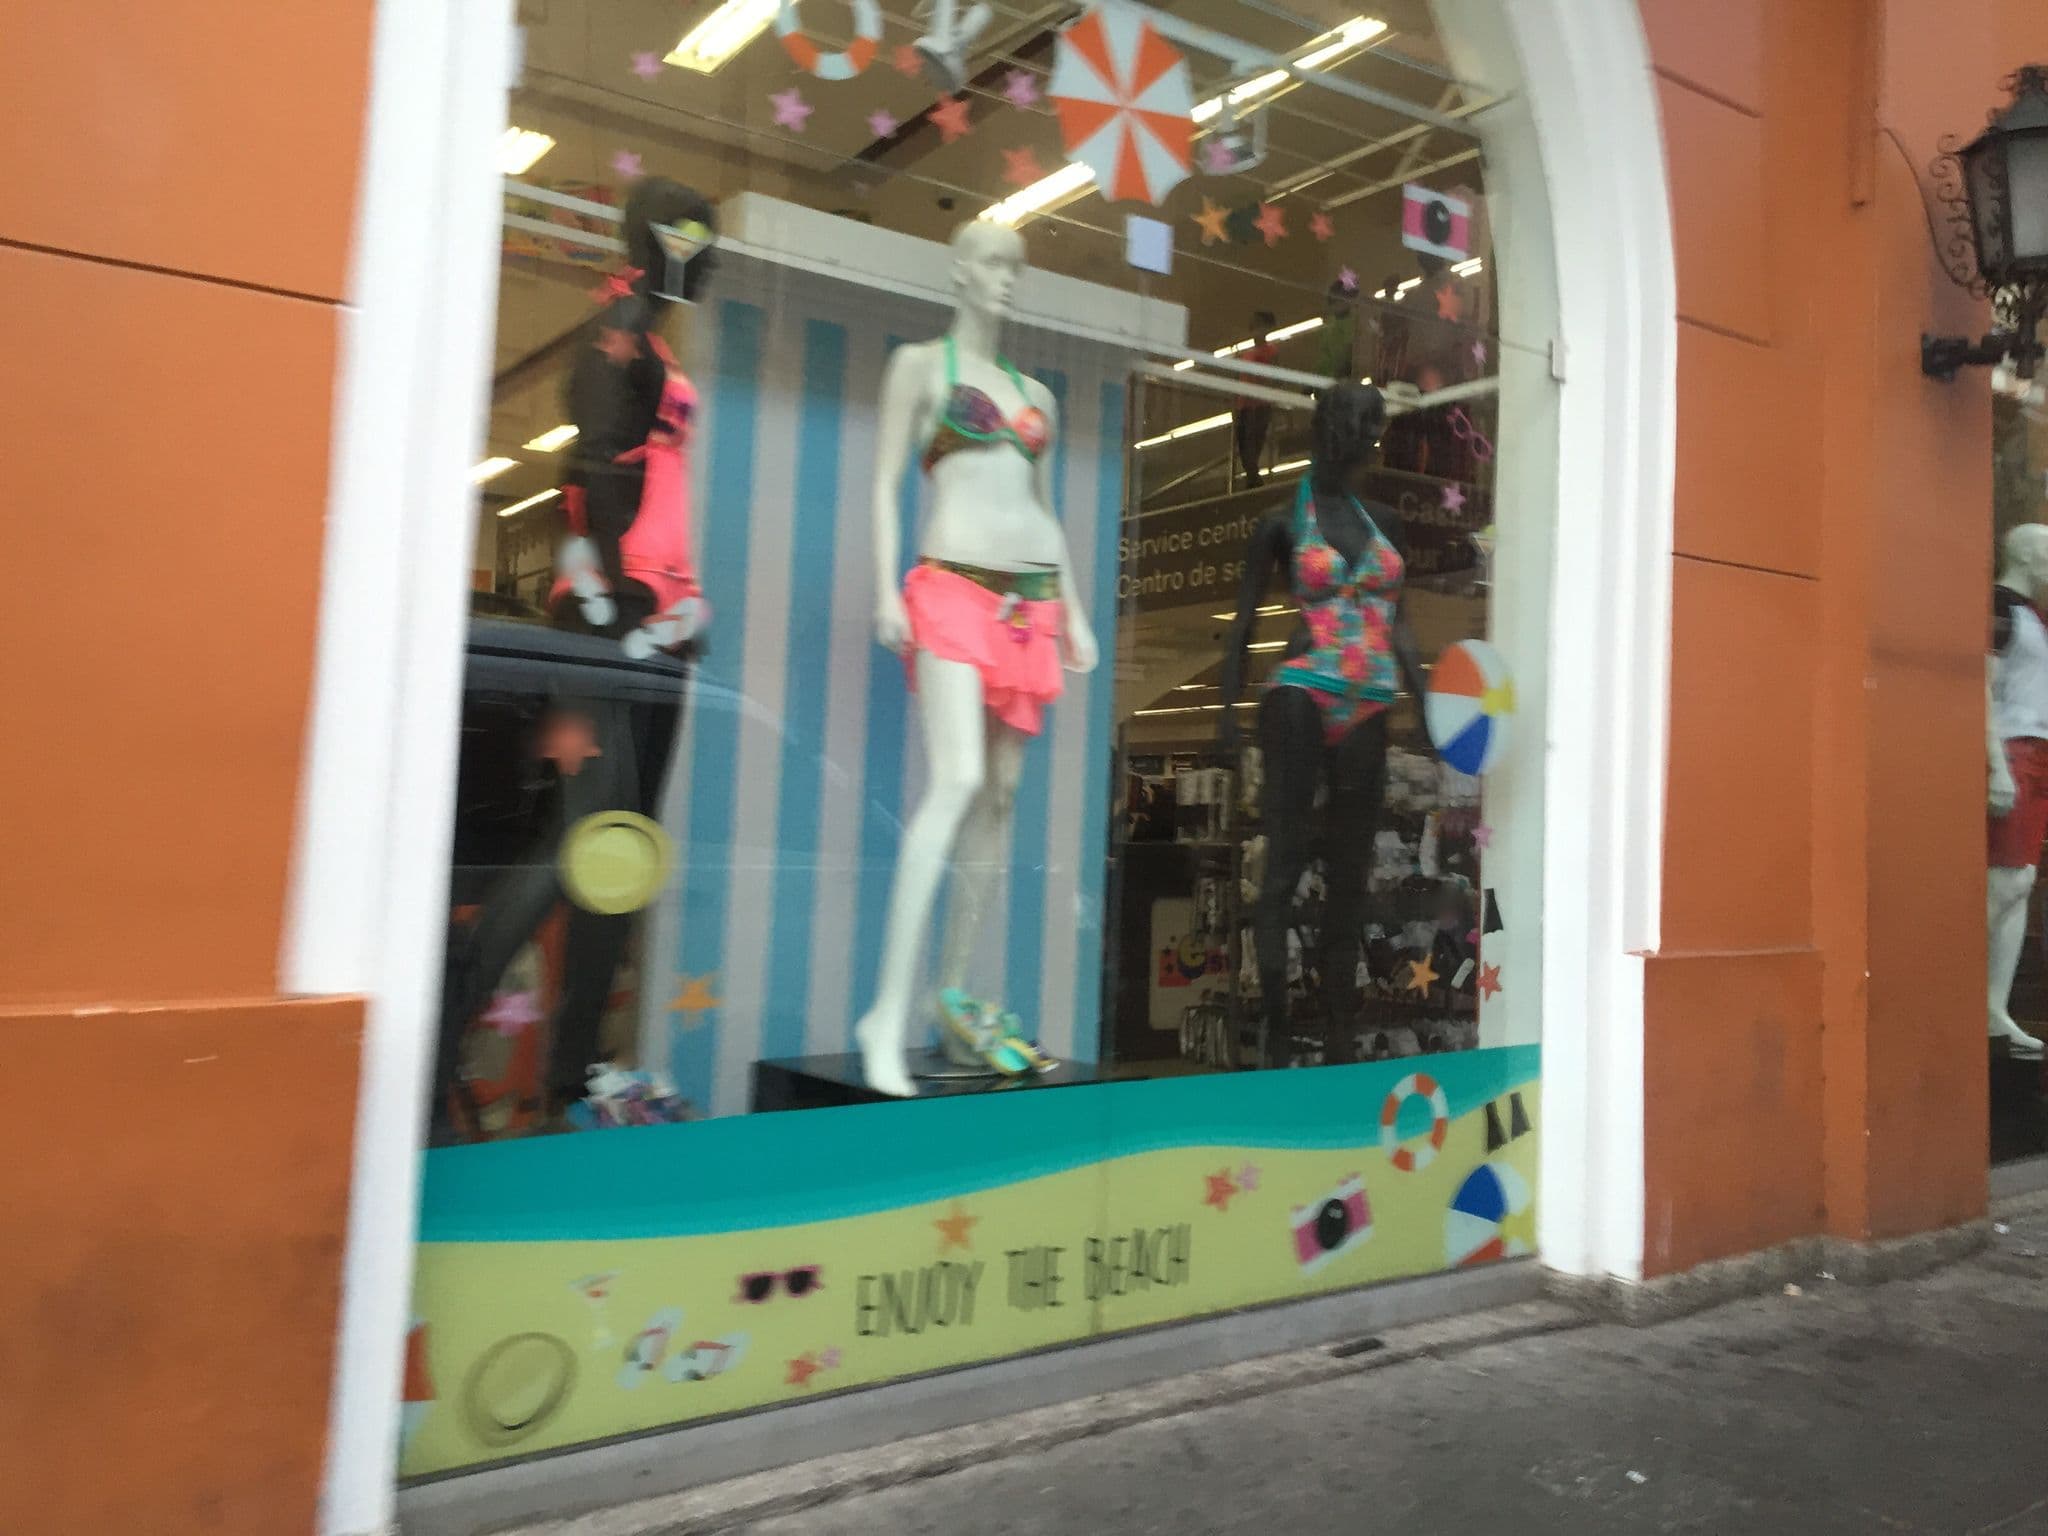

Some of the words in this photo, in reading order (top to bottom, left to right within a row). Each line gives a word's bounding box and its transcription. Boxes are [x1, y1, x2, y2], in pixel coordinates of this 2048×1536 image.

[1118, 530, 1193, 562] Service
[1197, 513, 1259, 547] cente
[1117, 566, 1184, 599] Centro
[1188, 560, 1217, 587] de
[1221, 560, 1248, 583] se
[856, 1260, 986, 1338] ENJOY
[1003, 1246, 1067, 1312] THE
[1083, 1222, 1192, 1302] BEACH
